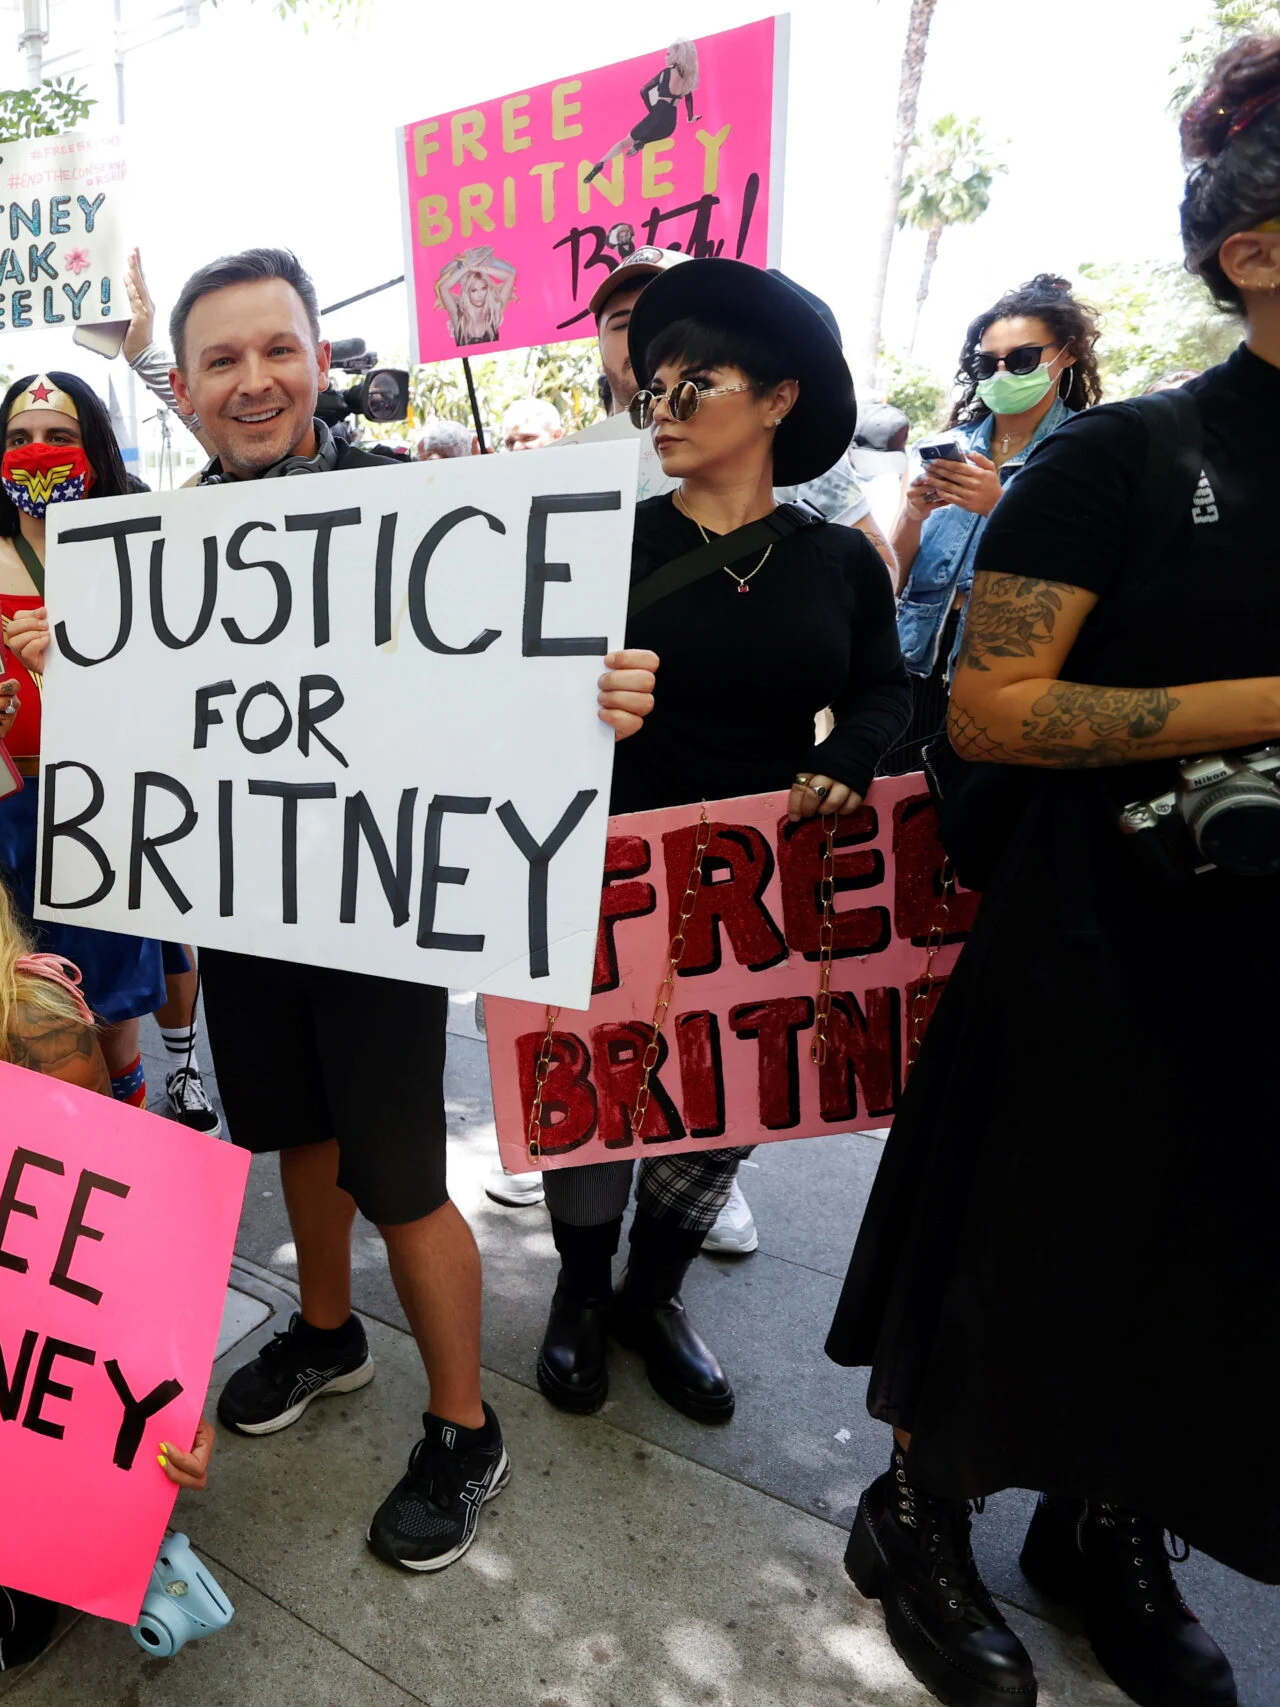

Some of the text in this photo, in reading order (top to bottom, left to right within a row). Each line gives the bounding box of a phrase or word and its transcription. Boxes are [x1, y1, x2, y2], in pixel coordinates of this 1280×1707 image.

[413, 79, 583, 178] FREE
[417, 123, 732, 247] BRITNEY
[54, 491, 621, 667] JUSTICE
[193, 674, 349, 768] FOR
[1194, 771, 1227, 787] Nikon
[41, 761, 598, 978] BRITNEY
[516, 975, 954, 1155] BRITN
